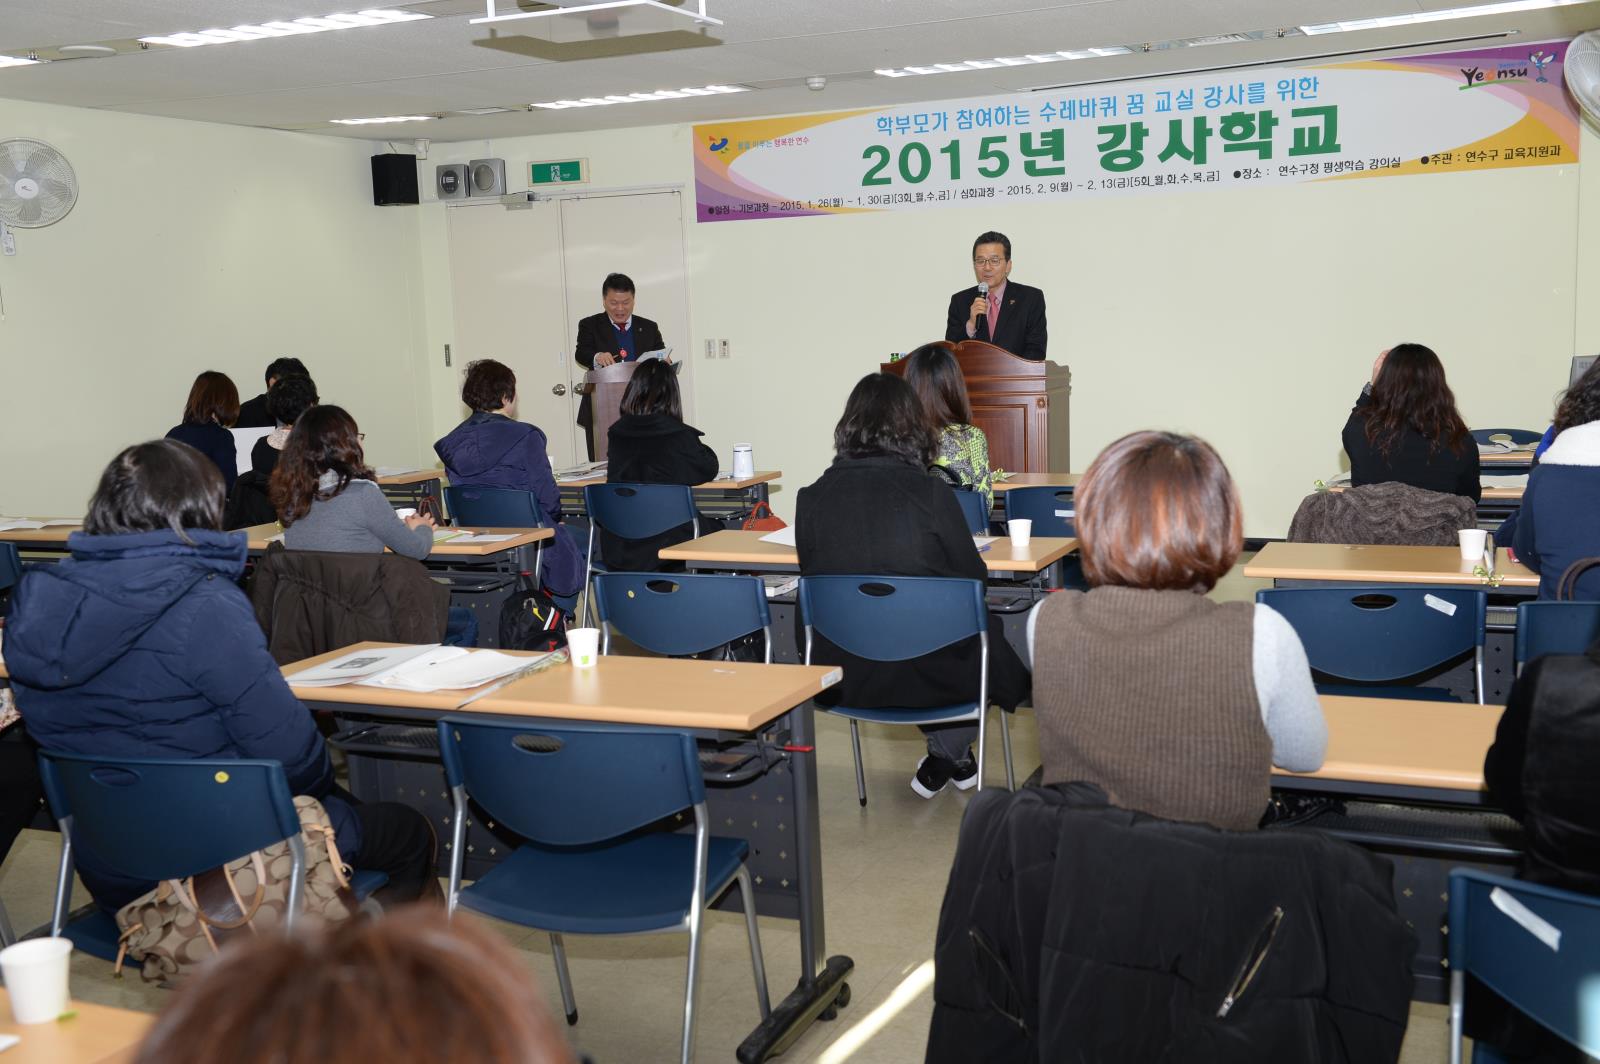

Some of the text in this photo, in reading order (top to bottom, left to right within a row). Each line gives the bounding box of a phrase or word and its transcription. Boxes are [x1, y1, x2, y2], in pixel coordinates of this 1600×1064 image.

[1461, 67, 1528, 86] Yeonsu
[876, 76, 1319, 136] 학부모가 참여하는 수레바퀴 꿈 교실 강사를 위한
[861, 104, 1341, 187] 2015년 강사학교
[1431, 153, 1453, 165] 주관
[1466, 149, 1499, 163] 연수구
[1504, 144, 1561, 160] 교육지원과
[1242, 167, 1262, 180] 장소
[1278, 163, 1319, 177] 연수구청
[1323, 159, 1365, 173] 평생학습
[1369, 156, 1401, 170] 강의실
[738, 202, 769, 214] 기본과정
[960, 186, 995, 200] 심화과정
